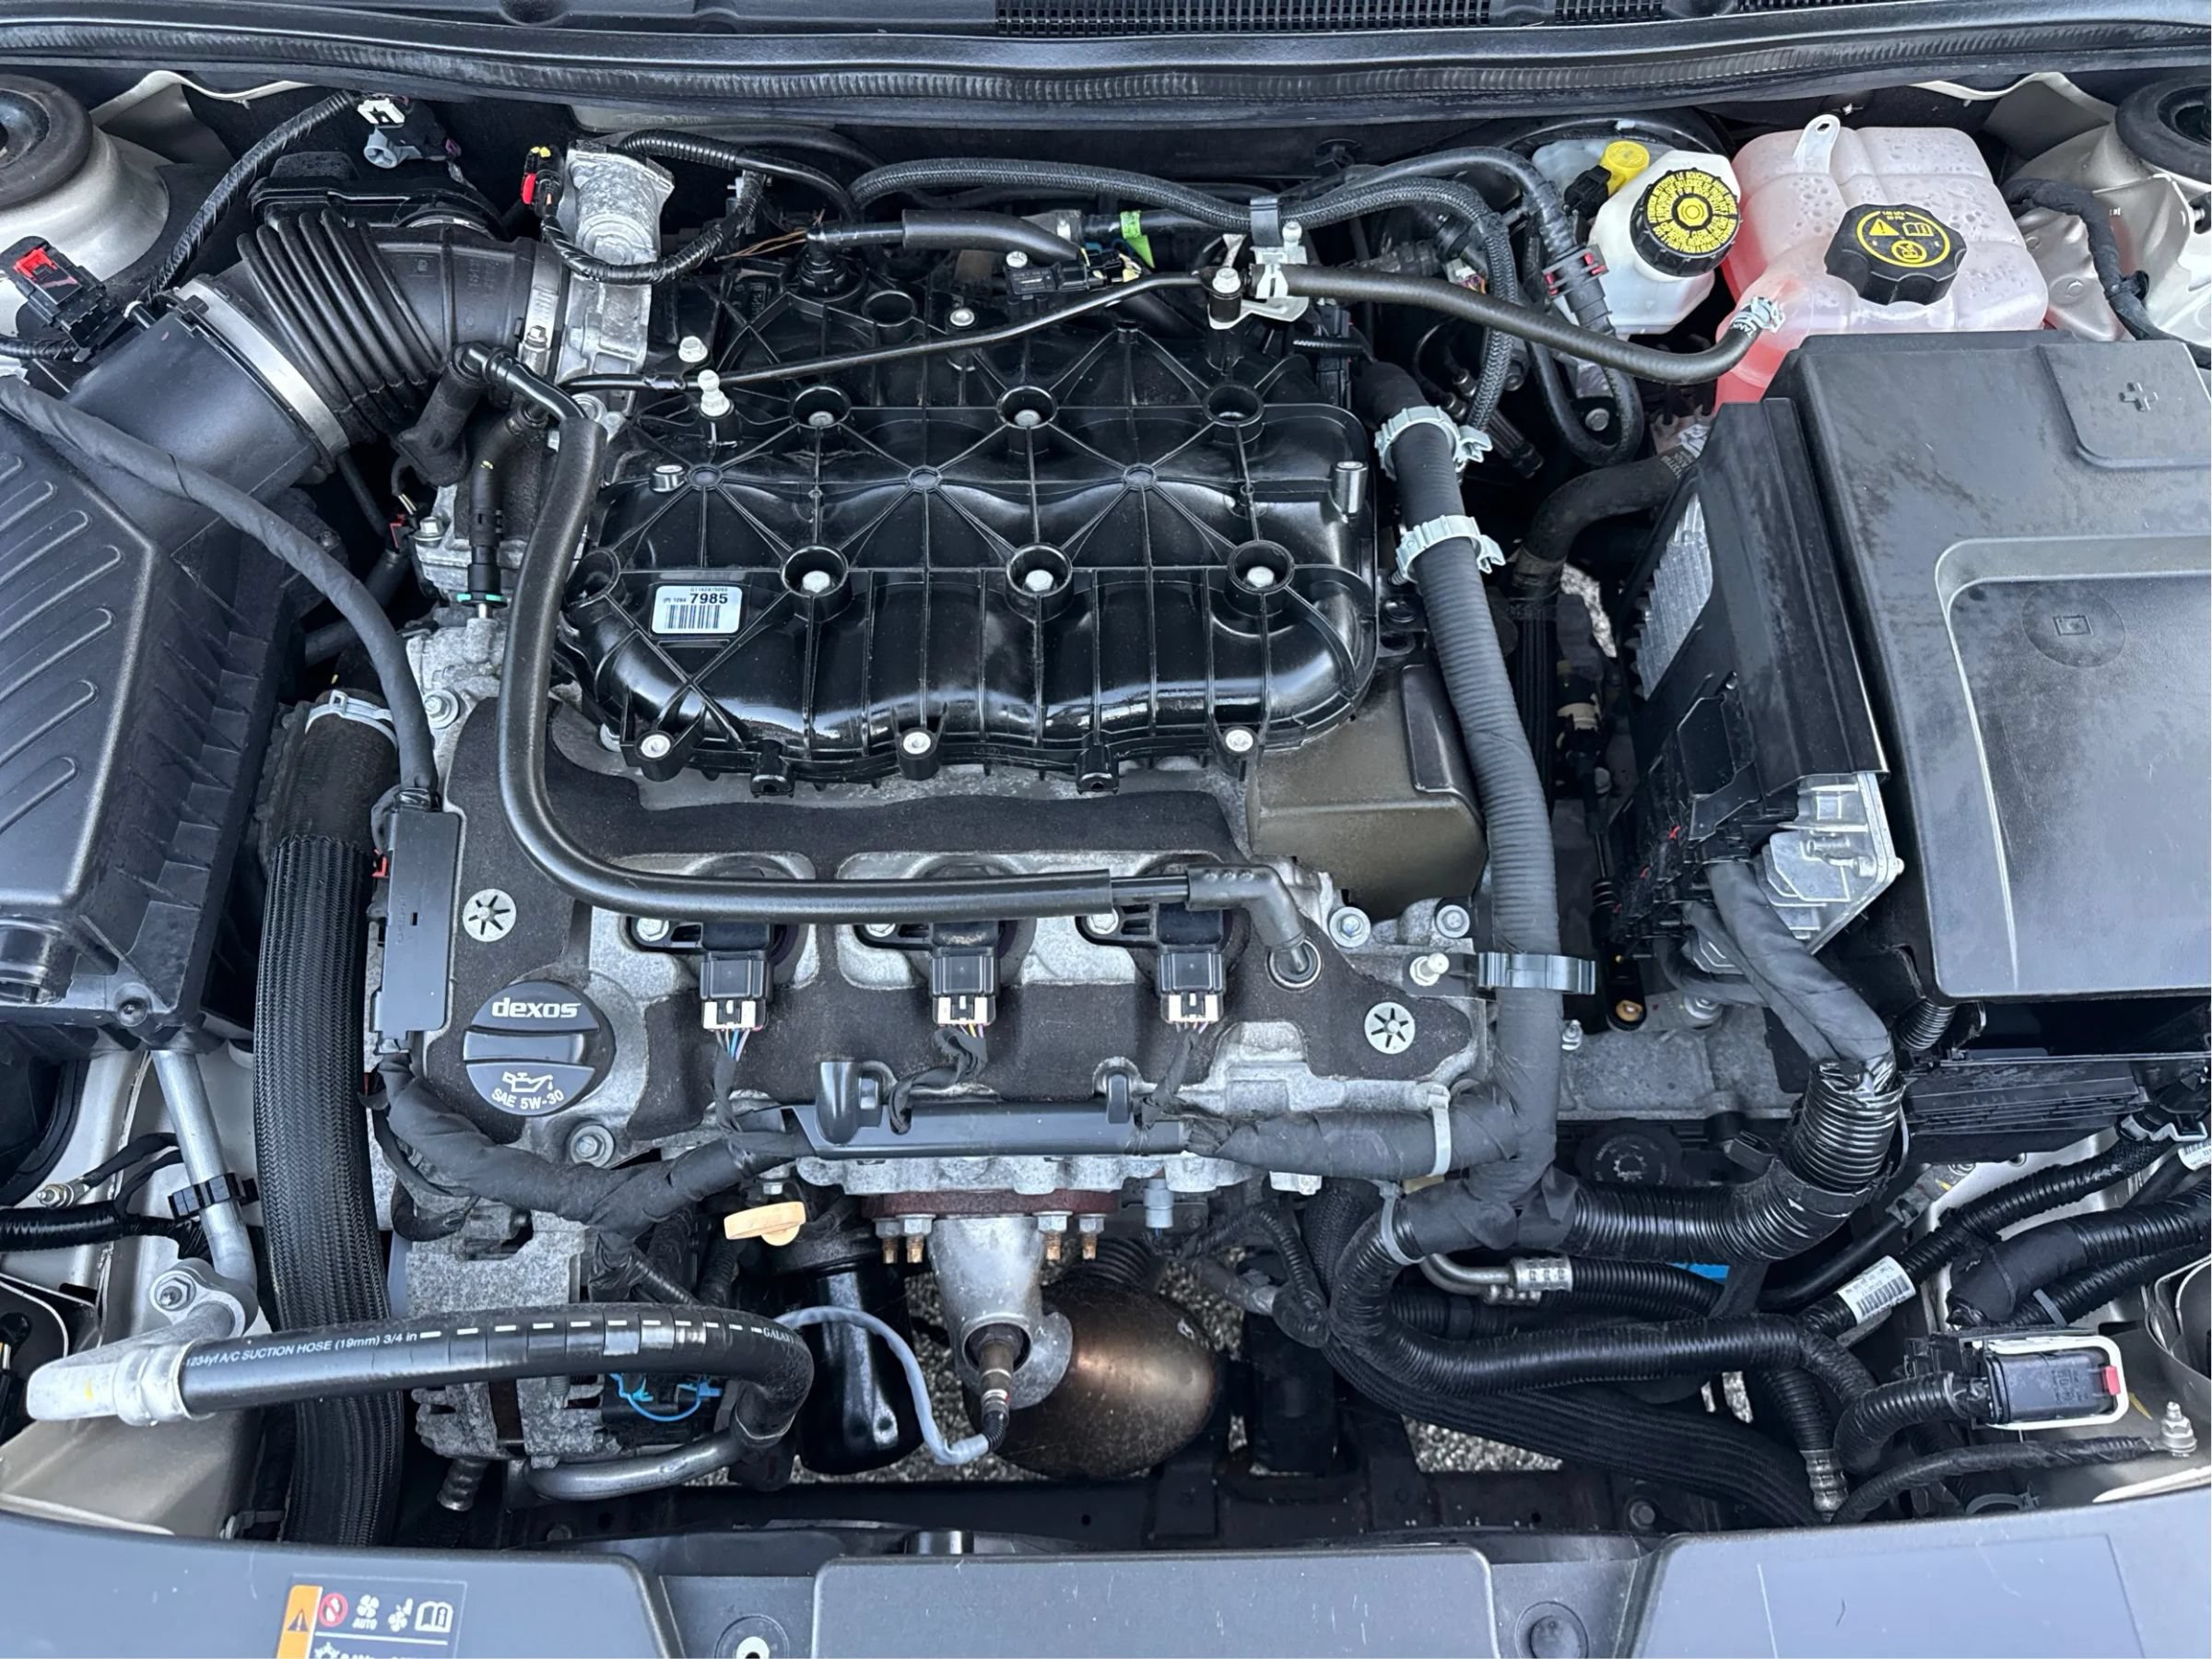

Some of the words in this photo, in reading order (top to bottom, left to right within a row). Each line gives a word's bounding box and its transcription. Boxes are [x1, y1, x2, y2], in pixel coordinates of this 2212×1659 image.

[690, 593, 728, 604] 7985
[492, 997, 581, 1018] dexos
[491, 1088, 517, 1108] SAE
[519, 1089, 565, 1111] 5W-30
[241, 1344, 294, 1361] SUCTION
[296, 1340, 332, 1353] HOSE
[335, 1335, 380, 1352] (19mm)
[382, 1334, 403, 1344] 3/4
[406, 1332, 417, 1342] in
[352, 1617, 378, 1630] AUTO
